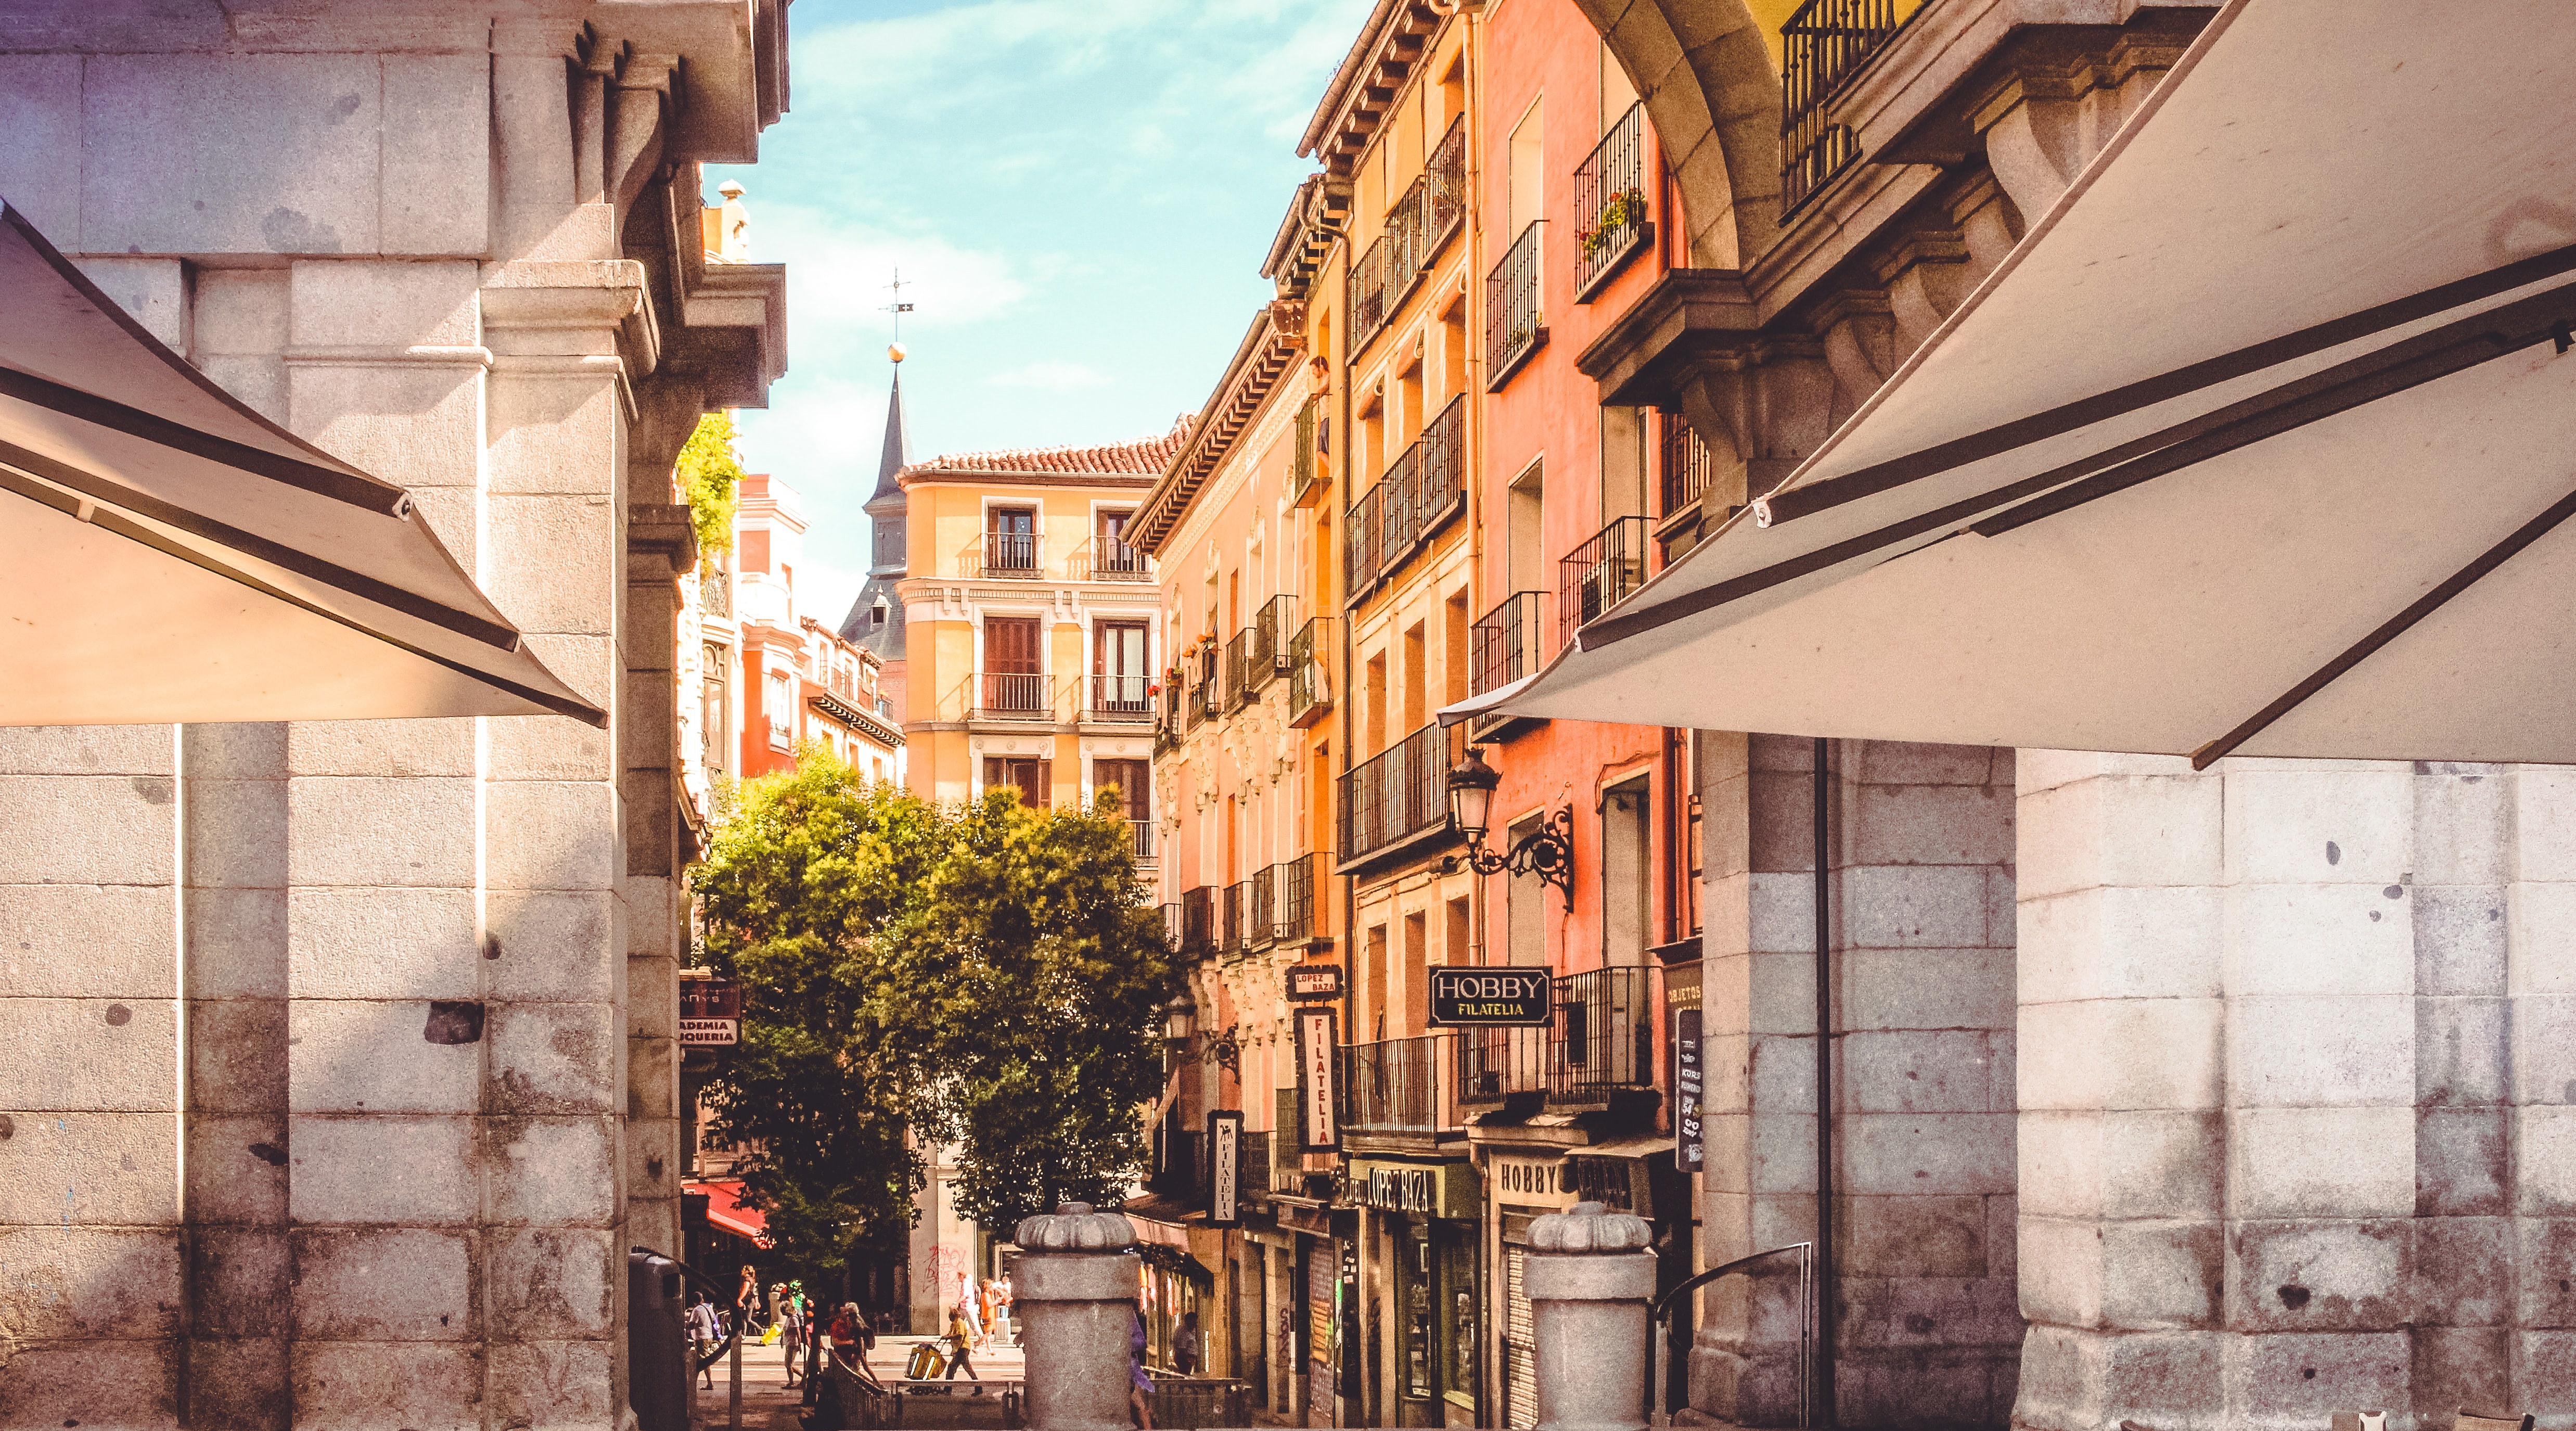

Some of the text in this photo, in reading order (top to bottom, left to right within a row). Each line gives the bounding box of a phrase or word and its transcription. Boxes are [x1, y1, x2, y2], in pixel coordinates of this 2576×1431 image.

[1439, 977, 1543, 999] HOBBY
[1668, 986, 1701, 1003] OBJETOS
[1458, 1003, 1523, 1015] FILATELIA
[1315, 1018, 1328, 1144] FILATELIA
[1220, 1144, 1232, 1219] FILATELIA
[1367, 1167, 1399, 1210] LOPEZ
[1401, 1170, 1429, 1212] BAZA
[1501, 1164, 1556, 1195] HOBBY
